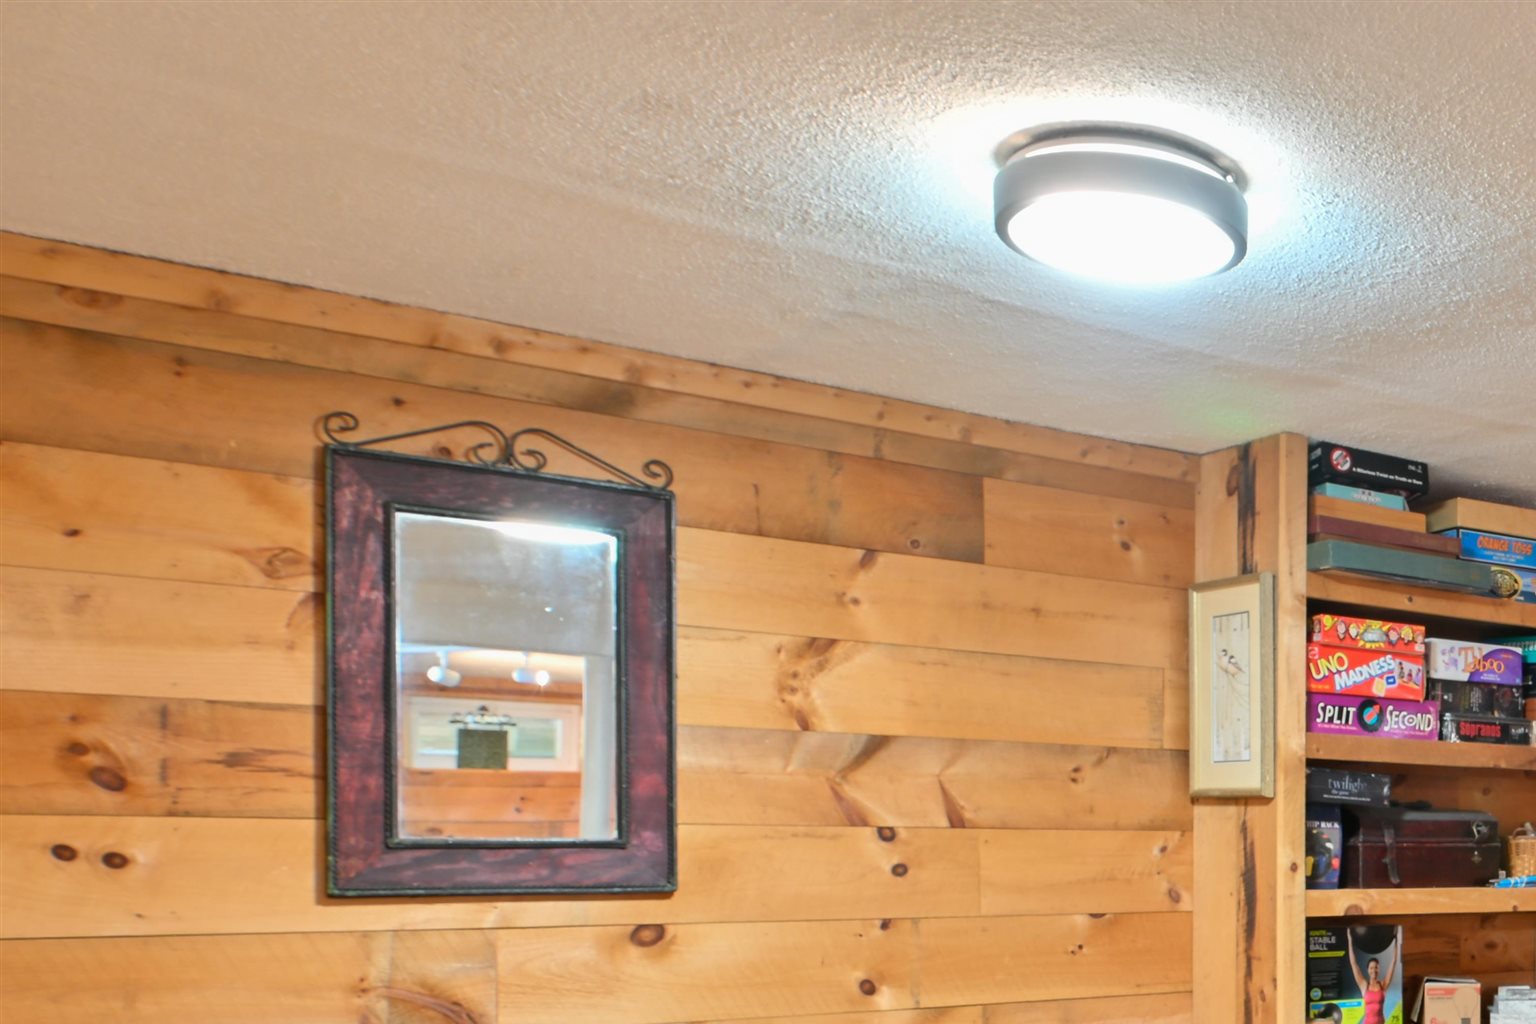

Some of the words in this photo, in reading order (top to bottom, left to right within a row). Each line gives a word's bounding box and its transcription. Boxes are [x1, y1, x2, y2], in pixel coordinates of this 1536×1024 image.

[1477, 535, 1509, 552] ORANGE
[1512, 541, 1533, 555] TOSS
[1309, 652, 1349, 680] UNO
[1334, 654, 1396, 691] MADNESS
[1458, 646, 1505, 674] Taboo
[1316, 702, 1356, 725] SPLIT
[1384, 705, 1434, 732] SECOND
[1459, 721, 1501, 738] Sopranos
